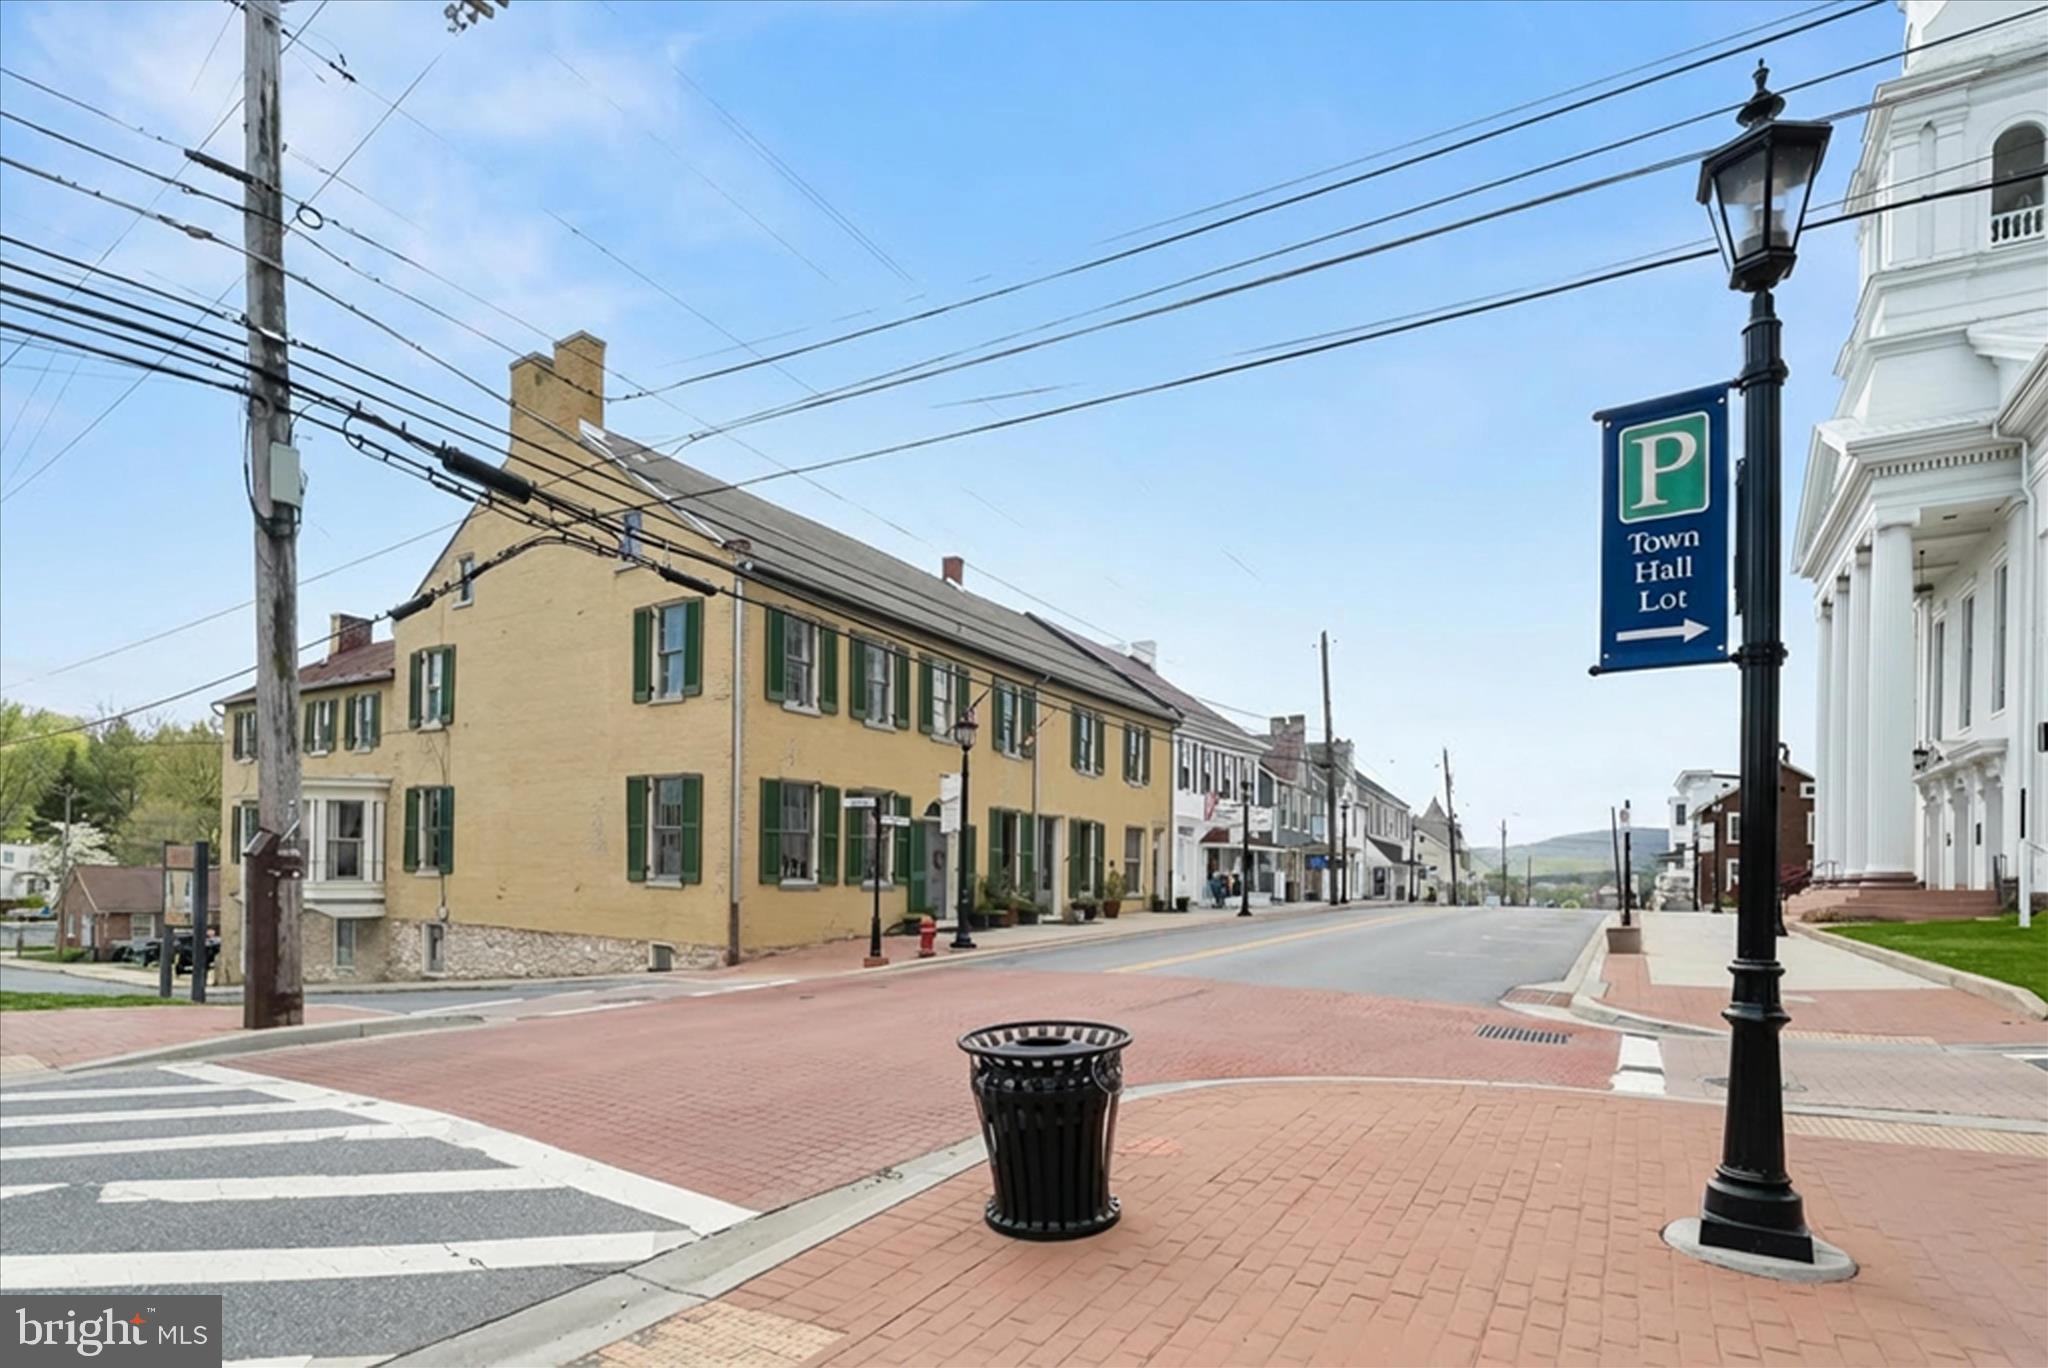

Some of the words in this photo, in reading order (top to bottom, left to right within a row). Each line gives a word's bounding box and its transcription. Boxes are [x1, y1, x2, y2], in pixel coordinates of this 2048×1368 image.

[1630, 430, 1698, 510] P
[1627, 530, 1700, 555] Town
[1634, 555, 1693, 584] Hall
[1638, 590, 1688, 613] Lot
